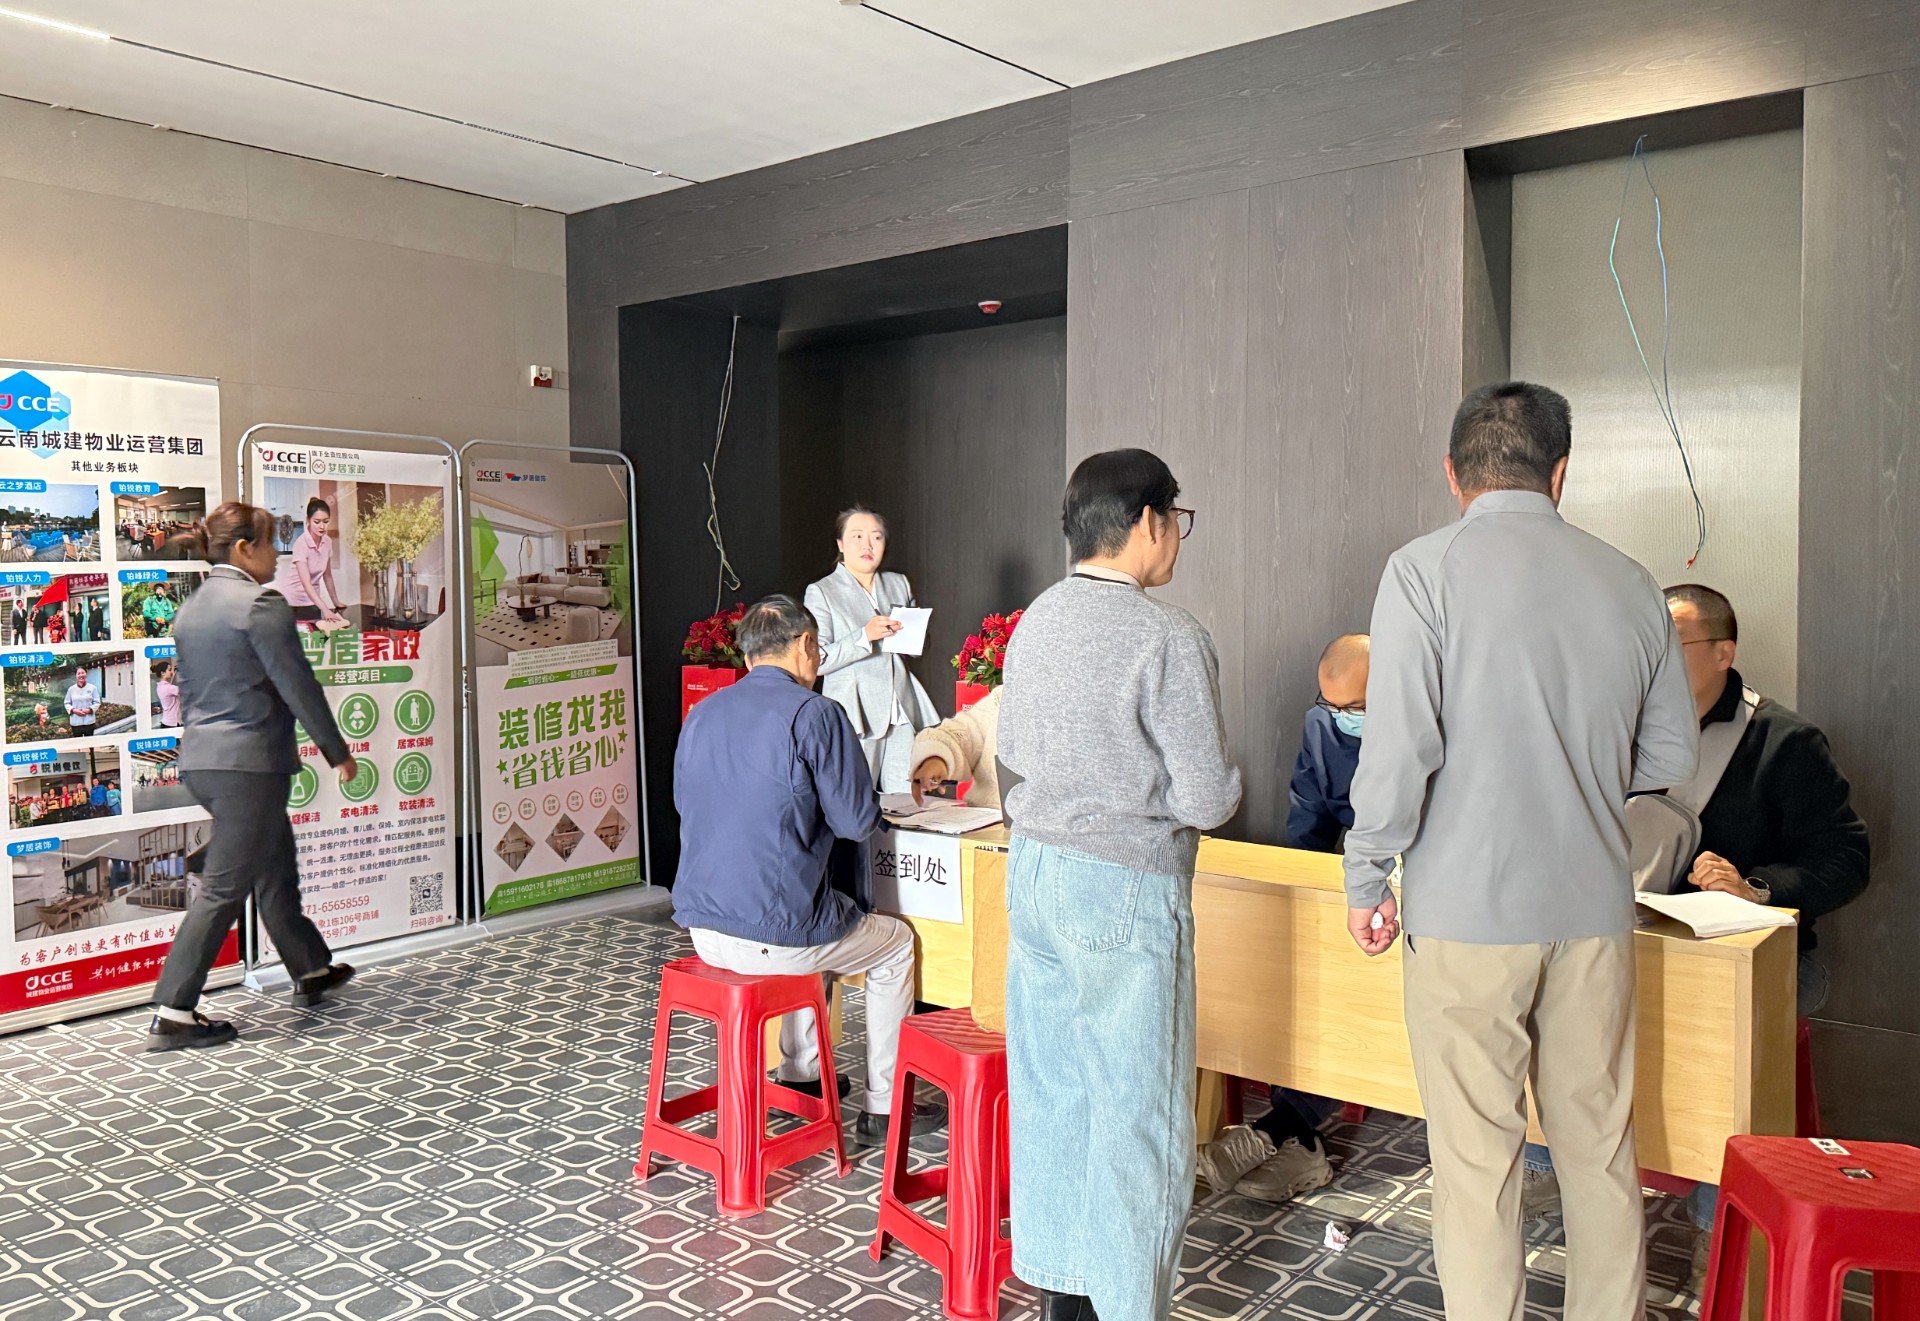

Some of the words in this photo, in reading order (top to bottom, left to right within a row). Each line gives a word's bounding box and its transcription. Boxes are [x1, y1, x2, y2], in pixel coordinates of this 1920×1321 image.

[17, 396, 62, 412] CCE
[0, 429, 204, 456] 云南城建物业运营集团
[277, 452, 308, 465] CCE
[71, 460, 140, 474] 其他业务板块
[262, 463, 308, 475] 城建物业集团
[328, 462, 367, 475] 梦居家政
[0, 480, 42, 491] 云之梦酒店
[6, 573, 42, 584] 铂锐人力
[8, 654, 45, 665] 铂锐清洁
[334, 669, 381, 685] 经营项目
[498, 688, 627, 750] 装修找我
[397, 736, 434, 750] 居家保姆
[12, 751, 49, 764] 铂锐餐饮
[298, 745, 319, 757] 月嫂
[512, 734, 619, 790] 省钱省心
[340, 804, 380, 819] 家电清洗
[398, 797, 436, 812] 软装清洗
[289, 811, 321, 826] 庭保洁
[16, 844, 53, 855] 梦居装饰
[874, 847, 948, 886] 签到处
[410, 914, 444, 929] 扫码咨询
[40, 970, 73, 987] CCE
